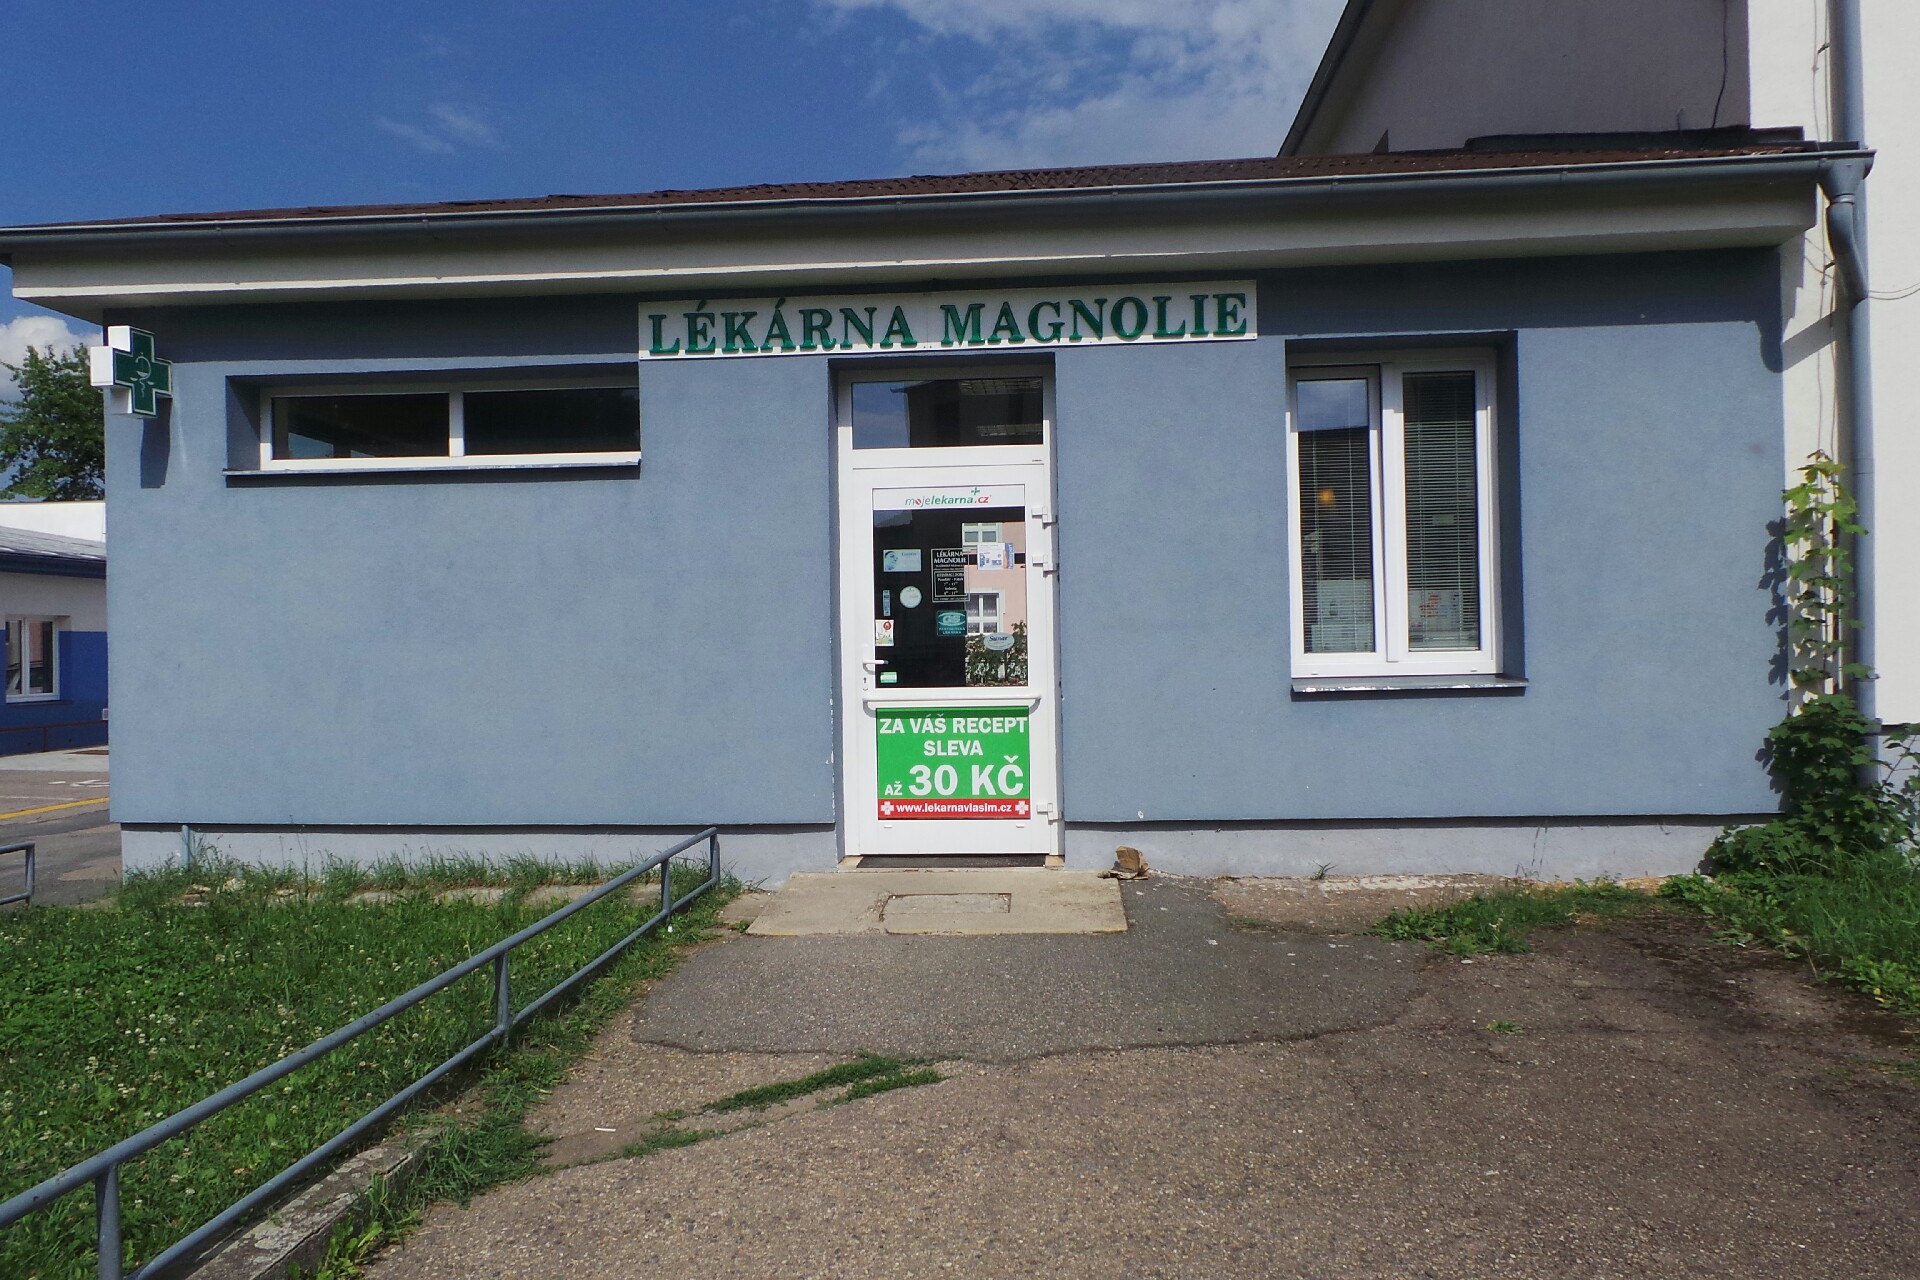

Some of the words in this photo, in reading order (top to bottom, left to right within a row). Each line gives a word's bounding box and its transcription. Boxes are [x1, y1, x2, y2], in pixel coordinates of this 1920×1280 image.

[648, 298, 918, 355] LÉKÁRNA
[940, 293, 1247, 347] MAGNOLIE
[880, 718, 905, 734] ZA
[910, 713, 947, 734] VÁŠ
[952, 717, 1028, 734] RECEPT
[924, 740, 984, 756] SLEVA
[884, 780, 903, 796] AŽ
[908, 764, 959, 796] 30
[971, 755, 1024, 796] KČ
[896, 802, 1012, 813] www.lekarnavlasim.cz
